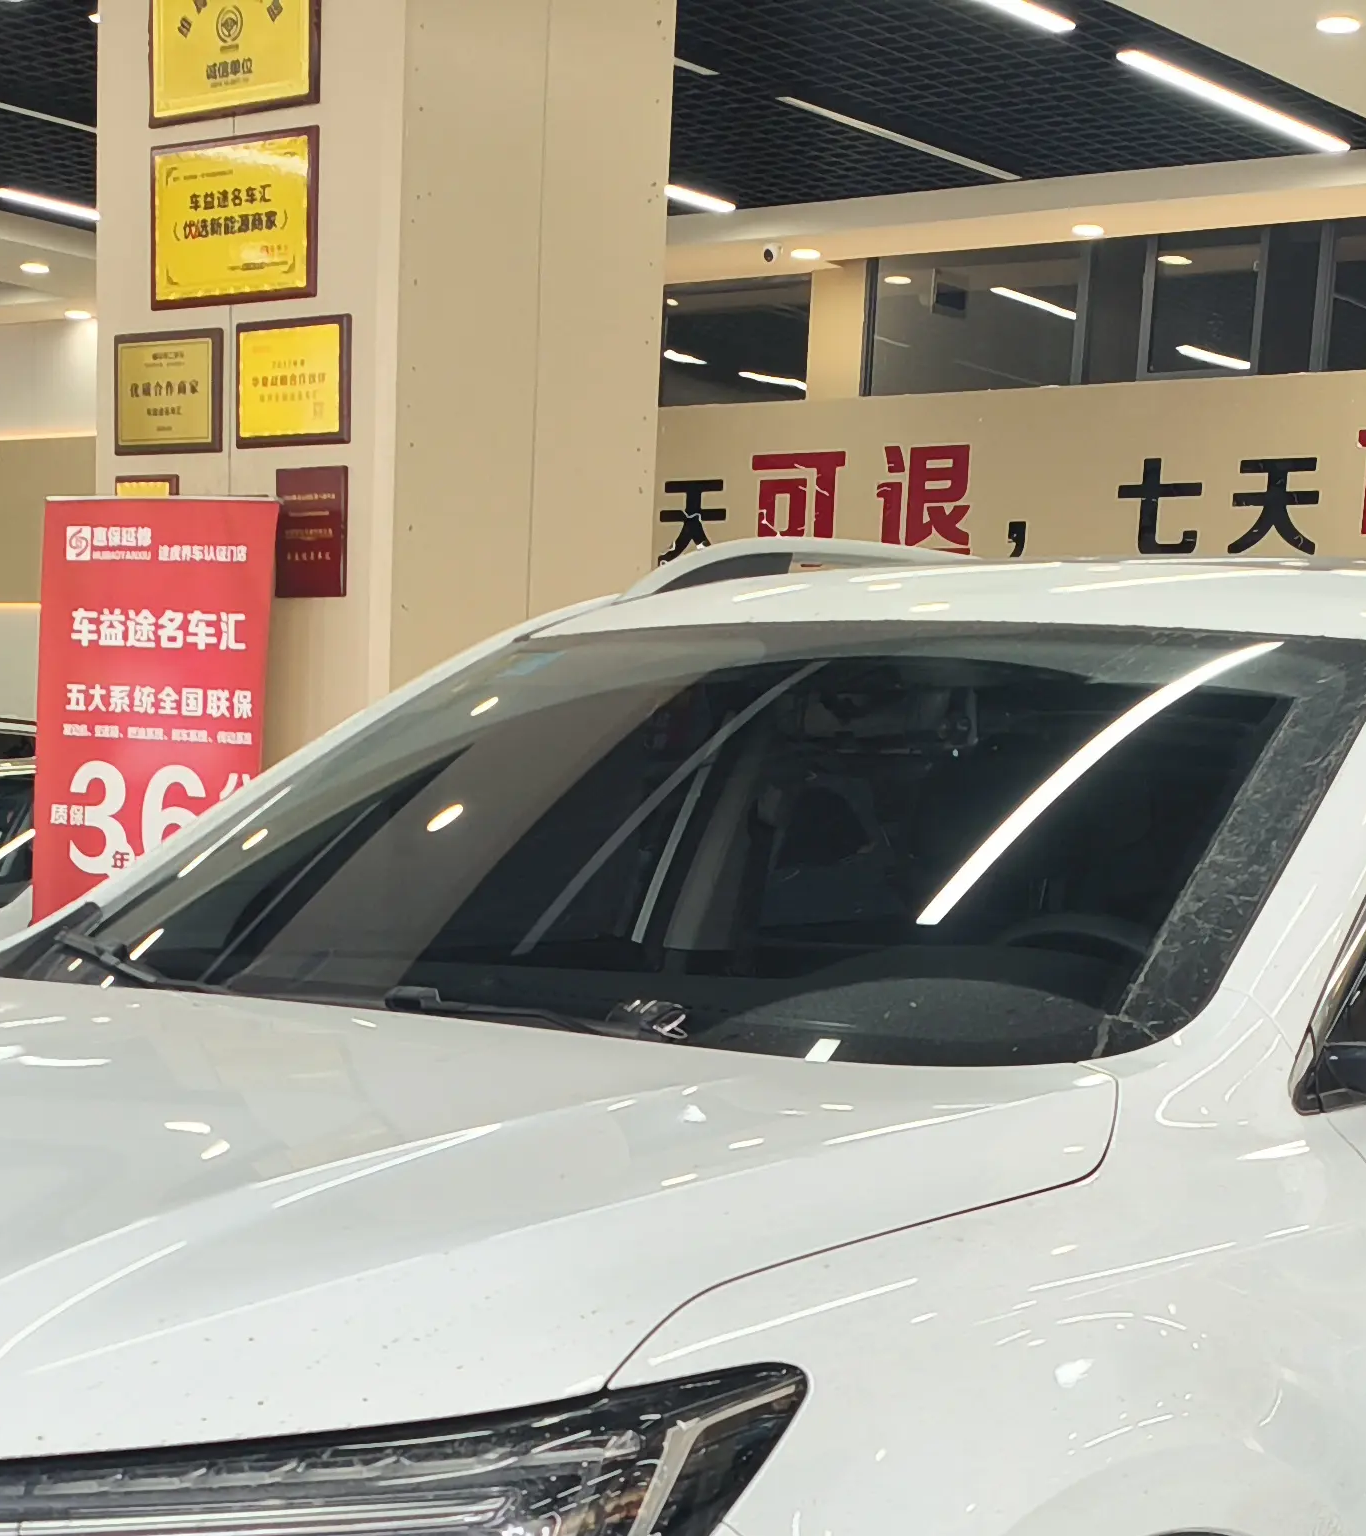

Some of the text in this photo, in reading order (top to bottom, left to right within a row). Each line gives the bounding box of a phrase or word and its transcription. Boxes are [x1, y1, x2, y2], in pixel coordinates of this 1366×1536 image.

[70, 608, 247, 651] 车益途名车汇
[65, 683, 253, 719] 五大系统全国联保
